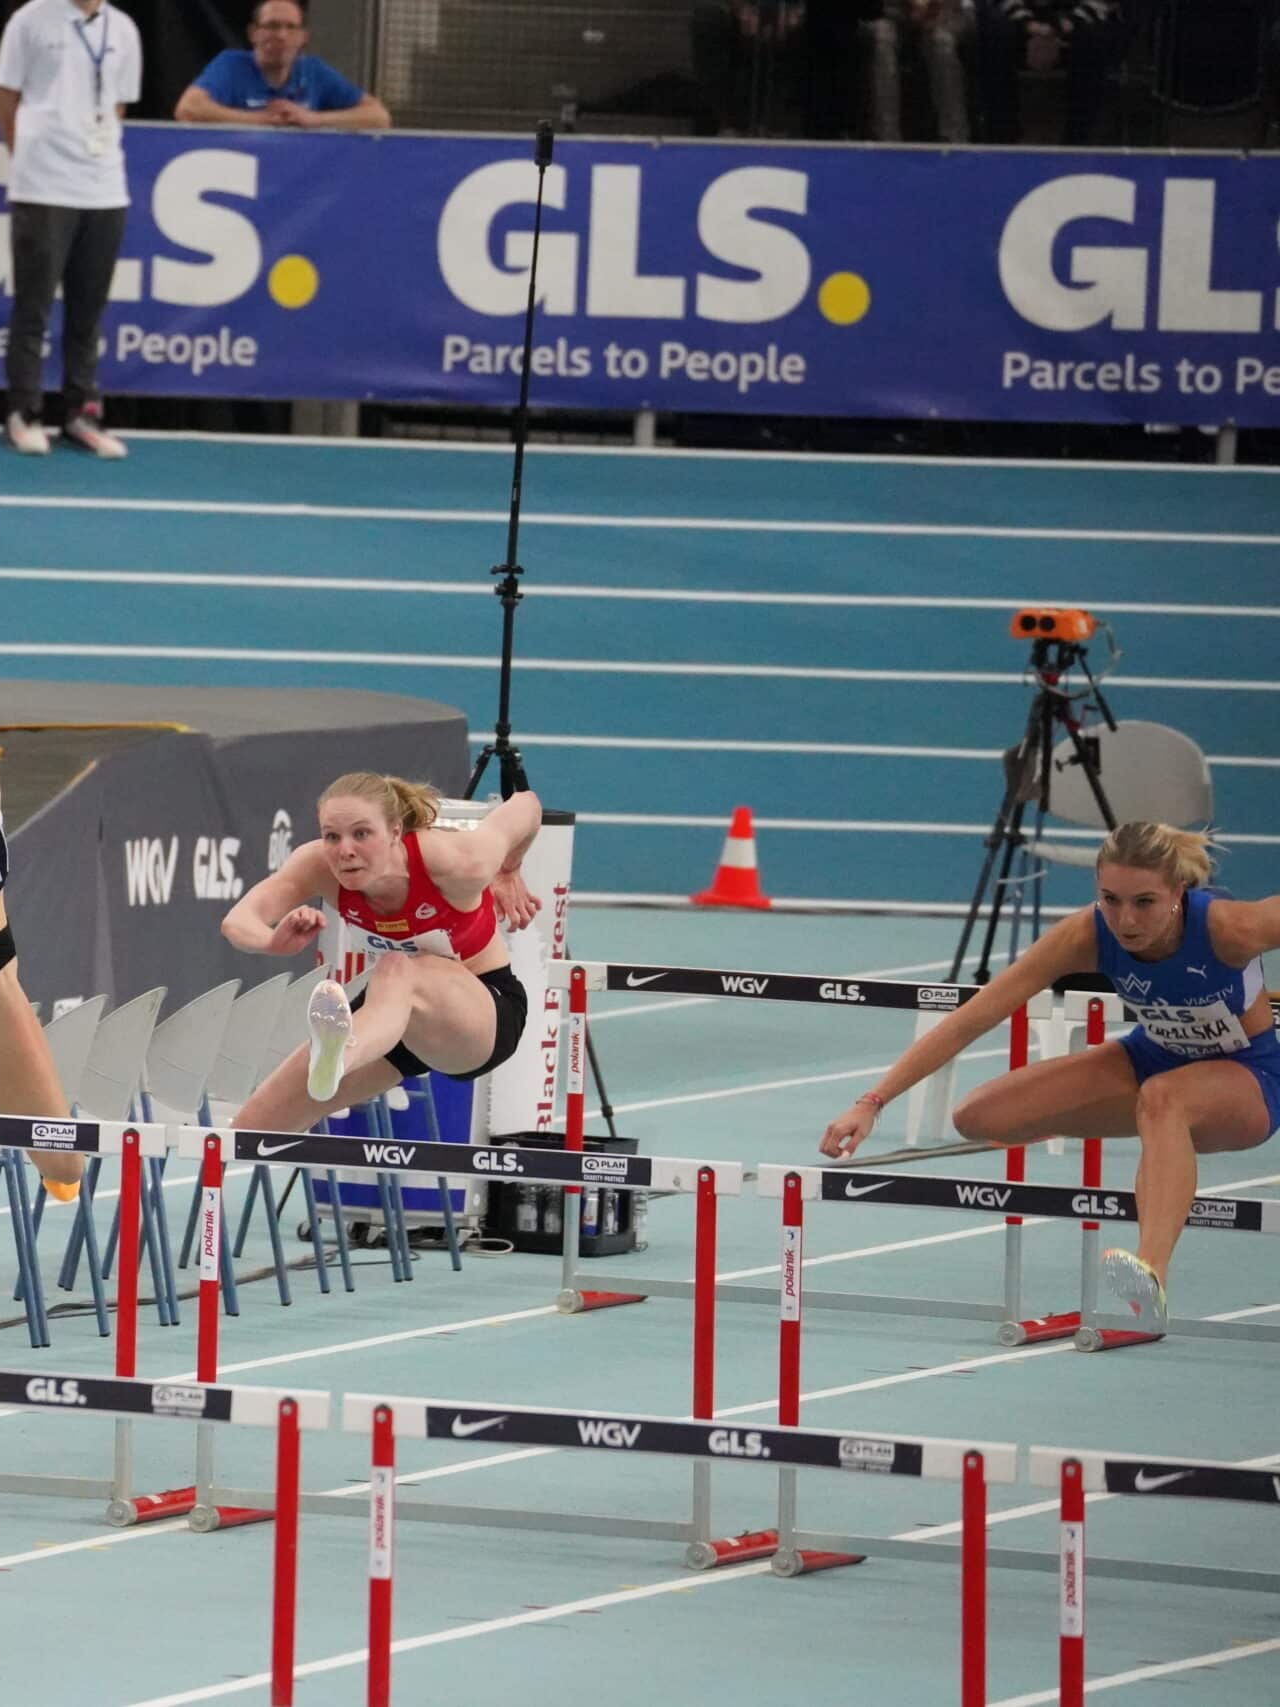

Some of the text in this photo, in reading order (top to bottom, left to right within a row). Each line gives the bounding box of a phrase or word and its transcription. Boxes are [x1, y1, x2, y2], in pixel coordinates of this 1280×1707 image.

[437, 158, 871, 326] GLS.
[997, 172, 1280, 334] GL
[116, 324, 258, 376] People
[441, 334, 806, 393] Parcels to People
[1001, 351, 1161, 393] Parcels
[1175, 357, 1222, 395] to
[721, 975, 769, 995] WGV
[819, 982, 866, 1002] GLS.
[363, 1144, 416, 1166] WGV
[472, 1151, 524, 1173] GLS.
[955, 1184, 1012, 1208] WGV
[1072, 1194, 1126, 1217] GLS.
[203, 1209, 215, 1258] polanik
[783, 1248, 796, 1297] polanik
[26, 1378, 88, 1406] GLS.
[578, 1419, 642, 1449] WGV
[708, 1429, 771, 1458] GLS.
